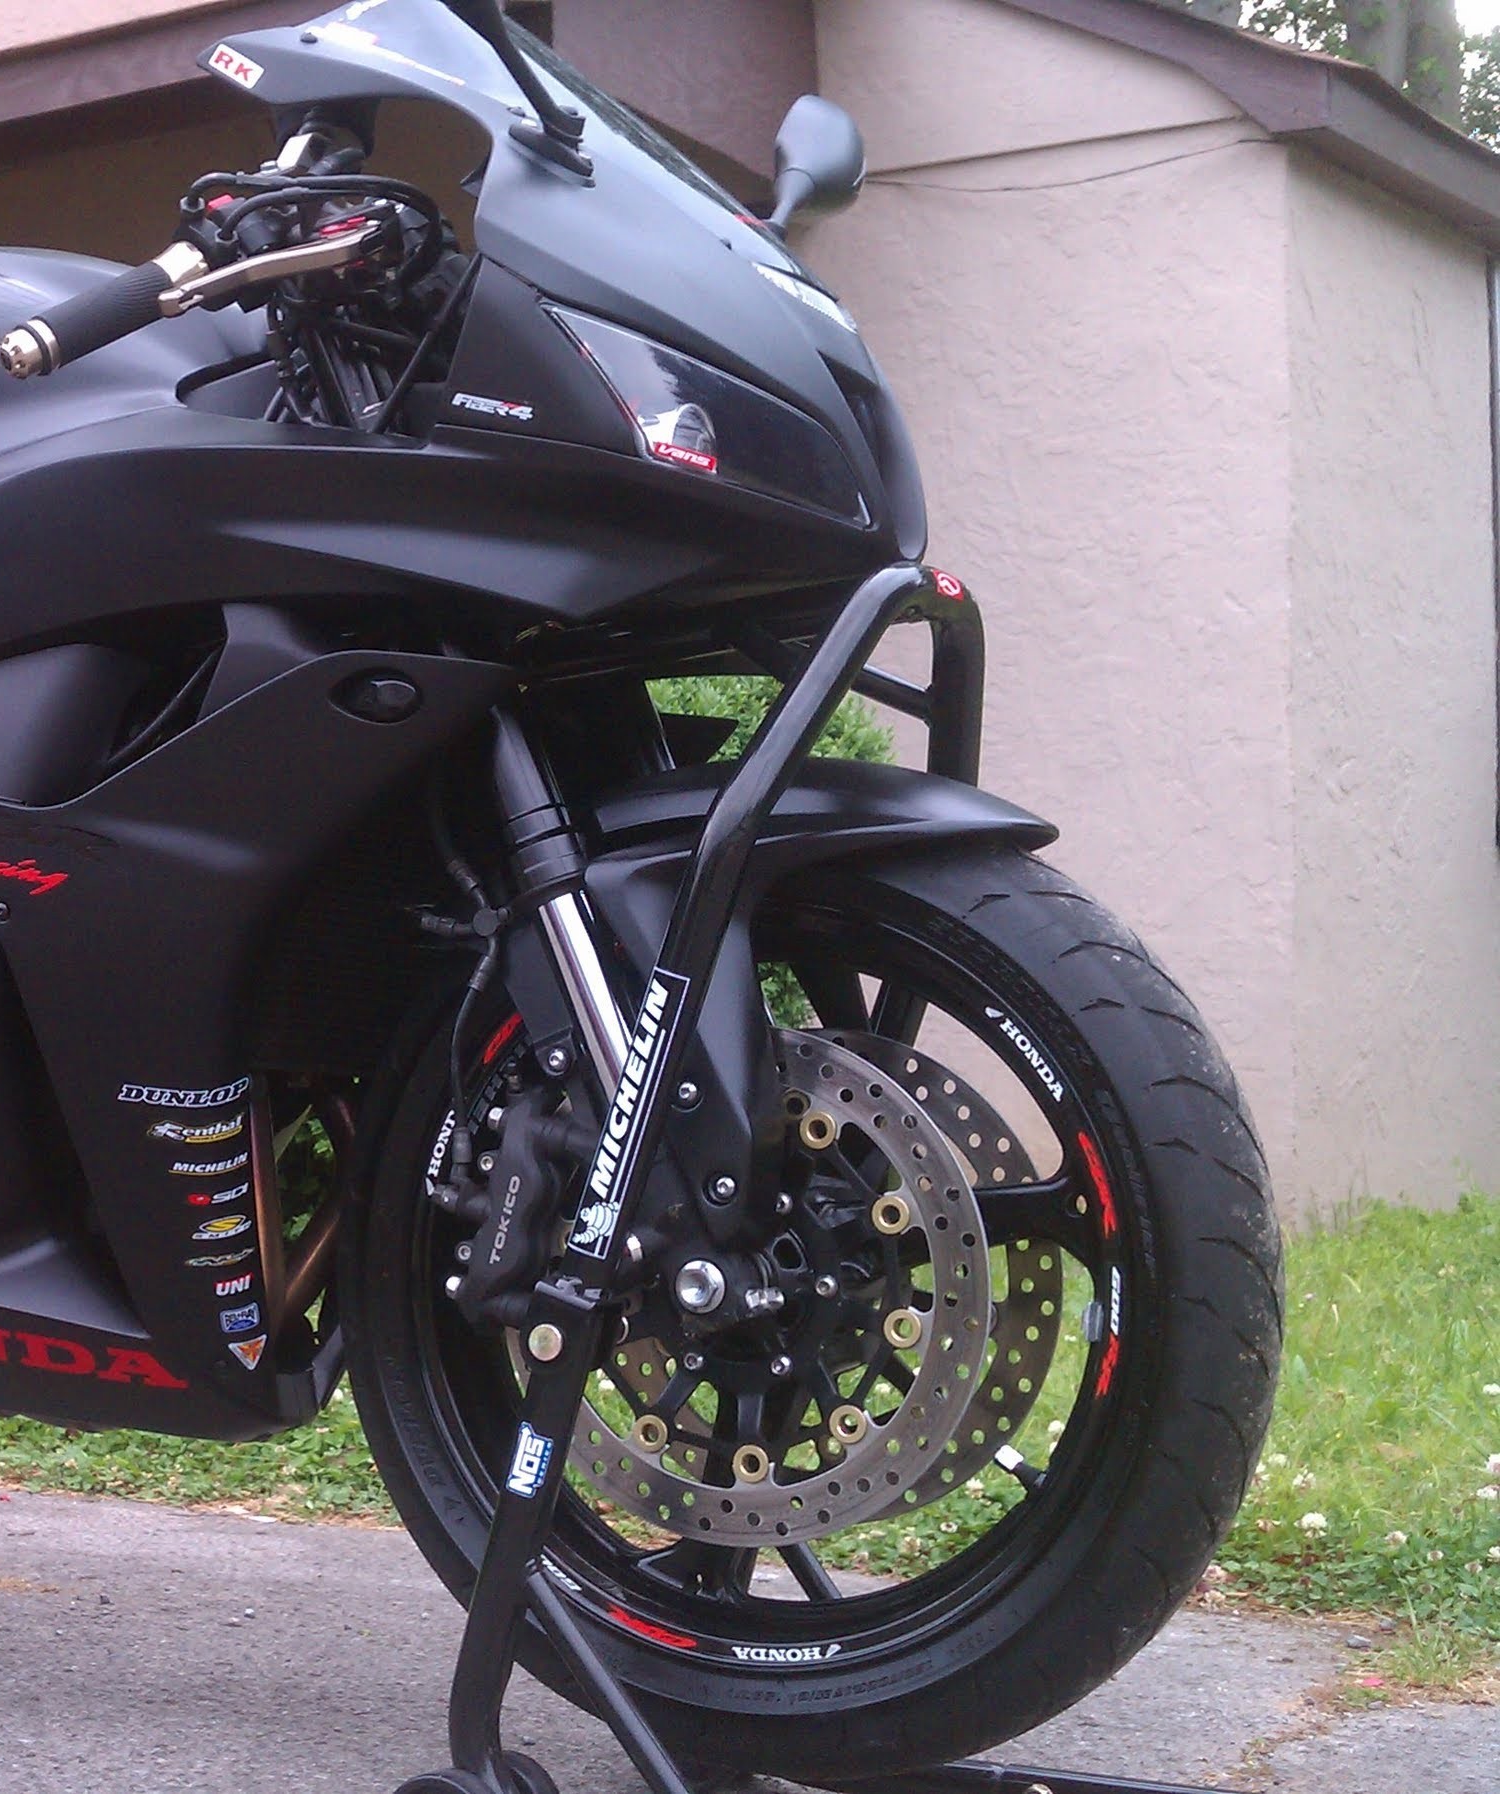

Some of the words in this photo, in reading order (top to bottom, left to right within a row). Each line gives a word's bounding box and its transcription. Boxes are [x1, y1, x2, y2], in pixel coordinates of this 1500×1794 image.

[213, 50, 255, 84] RK
[998, 1015, 1066, 1103] HONDA
[117, 1077, 250, 1108] DUNLOP
[589, 977, 670, 1200] MICHELIN
[172, 1151, 249, 1174] MICHELIN
[488, 1175, 521, 1265] TOKICO
[215, 1273, 252, 1297] UNI
[508, 1426, 545, 1496] NOS
[730, 1646, 823, 1662] HONDA
